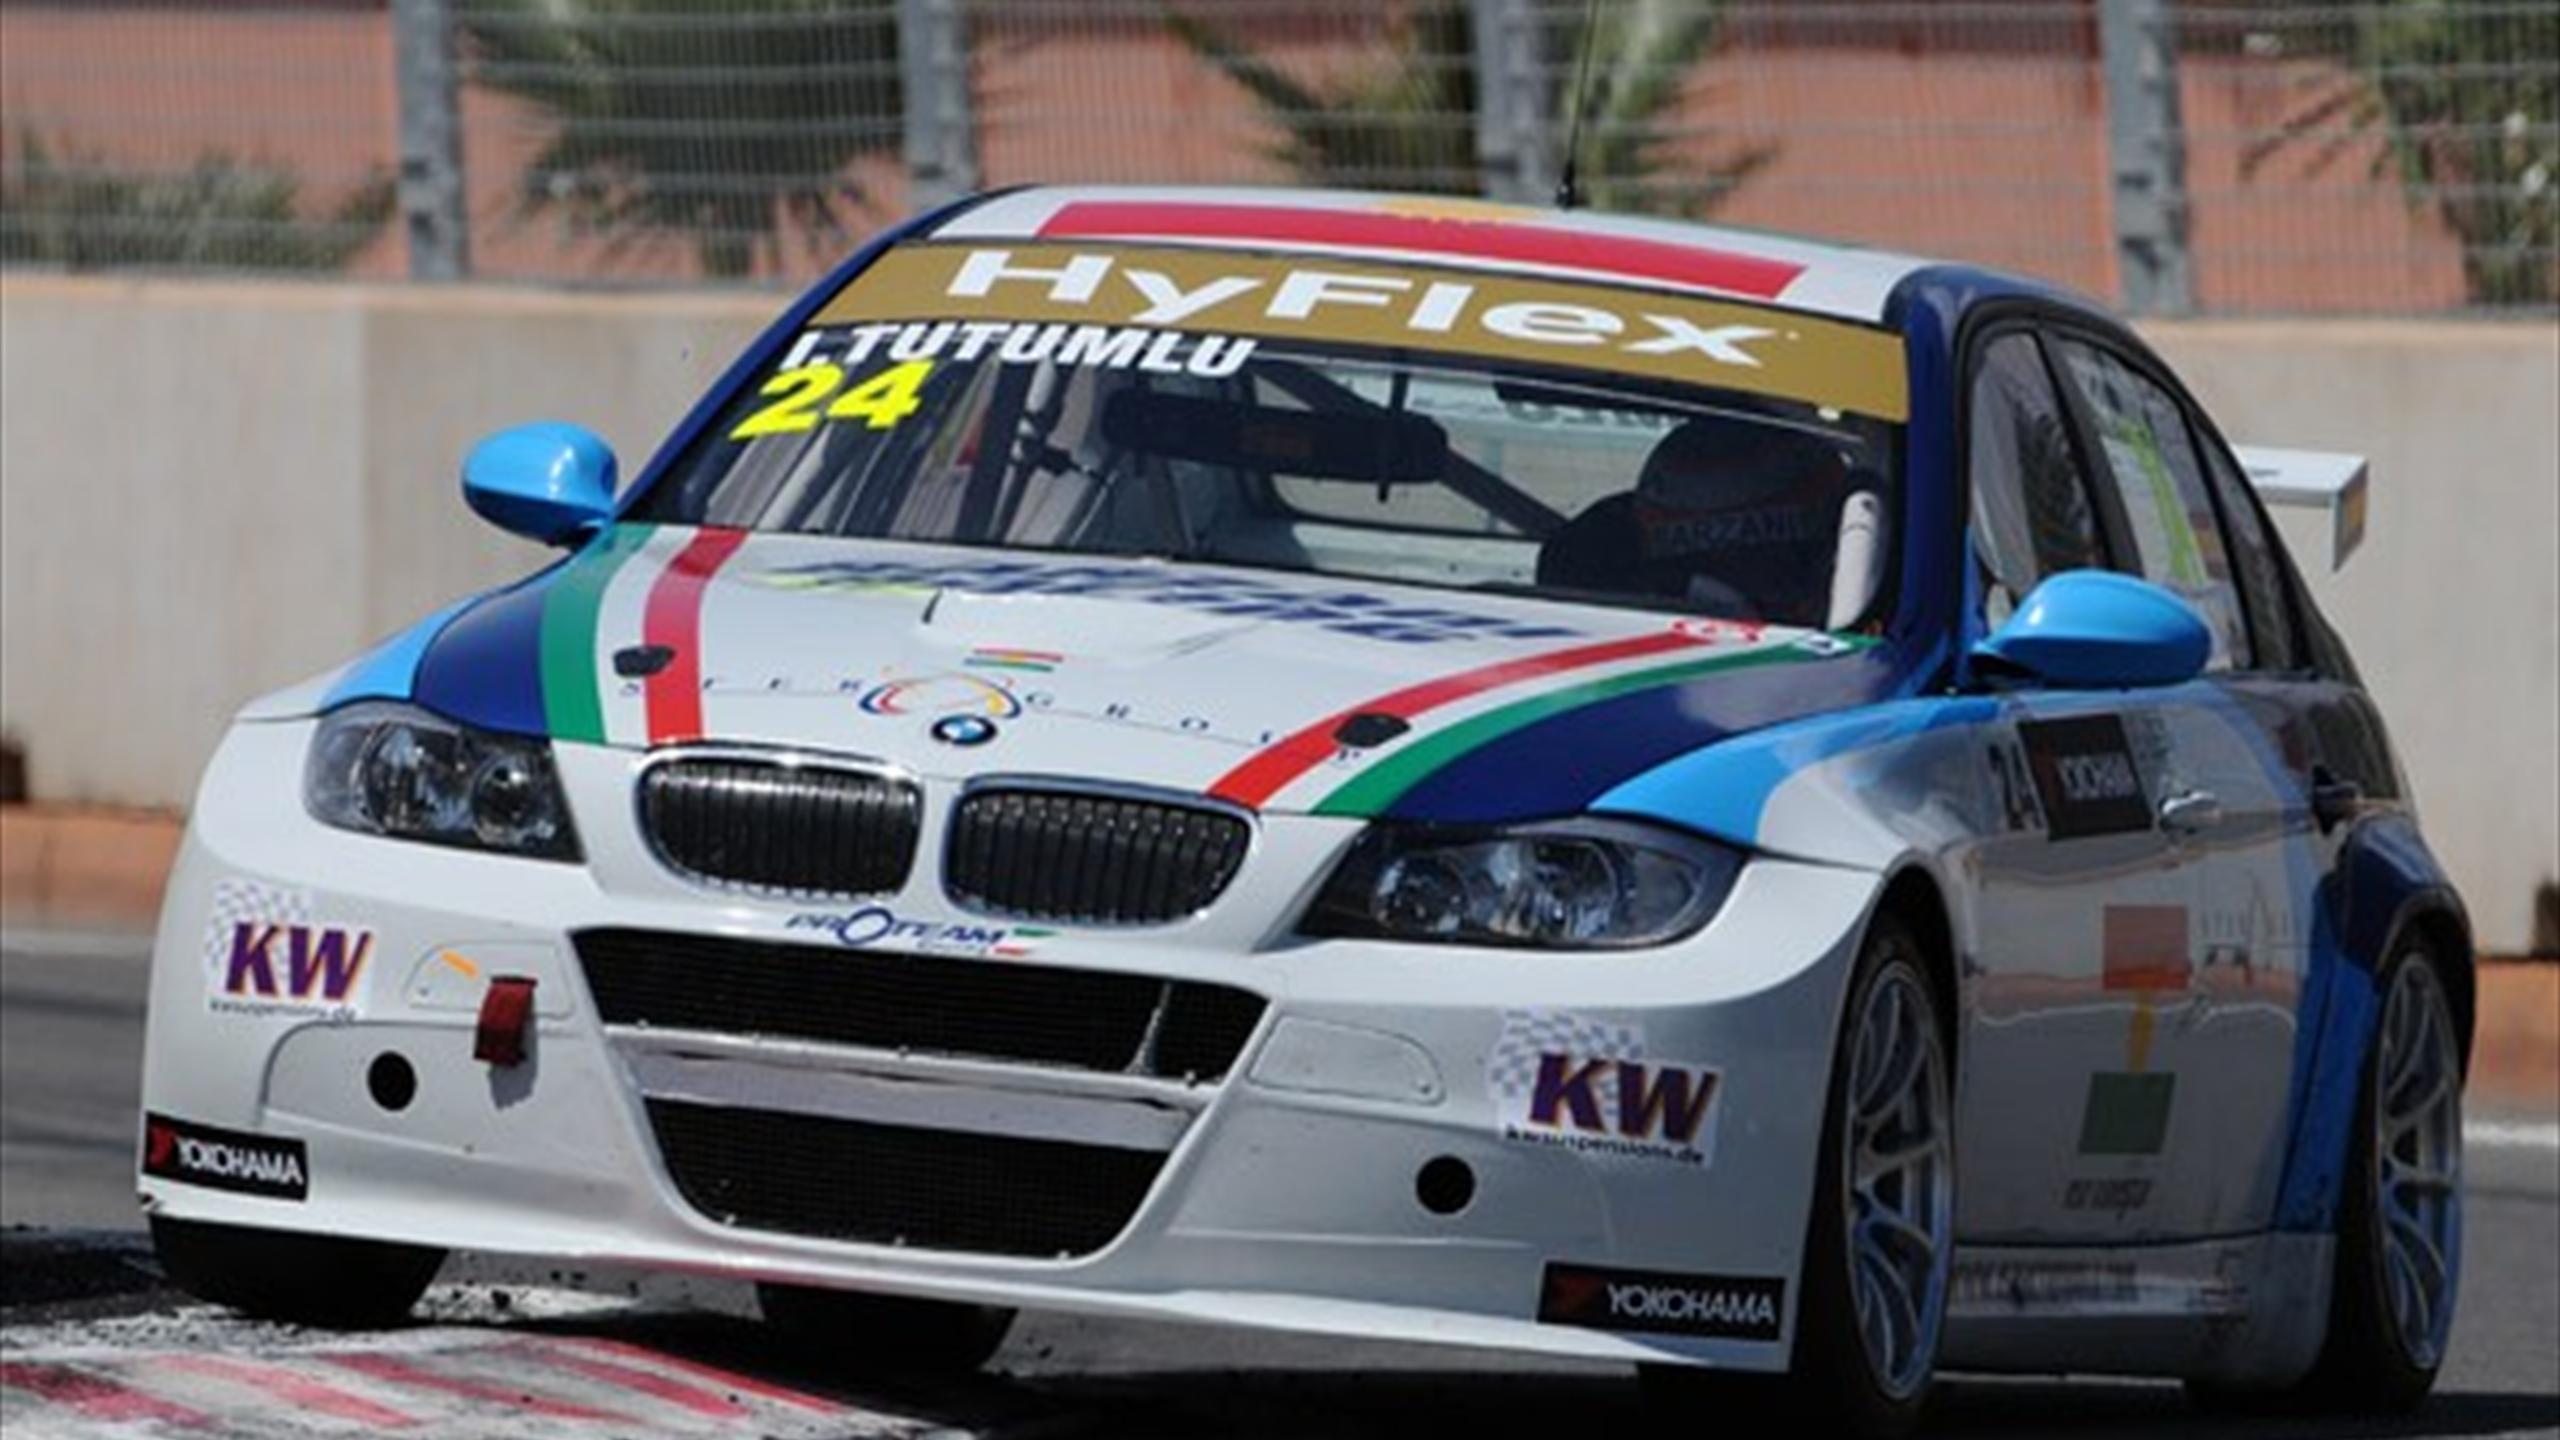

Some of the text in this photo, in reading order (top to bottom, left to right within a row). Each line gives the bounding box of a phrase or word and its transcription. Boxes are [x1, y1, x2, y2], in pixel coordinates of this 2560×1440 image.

[946, 248, 1778, 368] HyFlex
[729, 359, 935, 440] 24
[225, 921, 374, 1001] KW
[1528, 1052, 1720, 1144] KW
[174, 1135, 305, 1185] YOKOHAMA
[1605, 1282, 1777, 1325] YOKOHAMA
